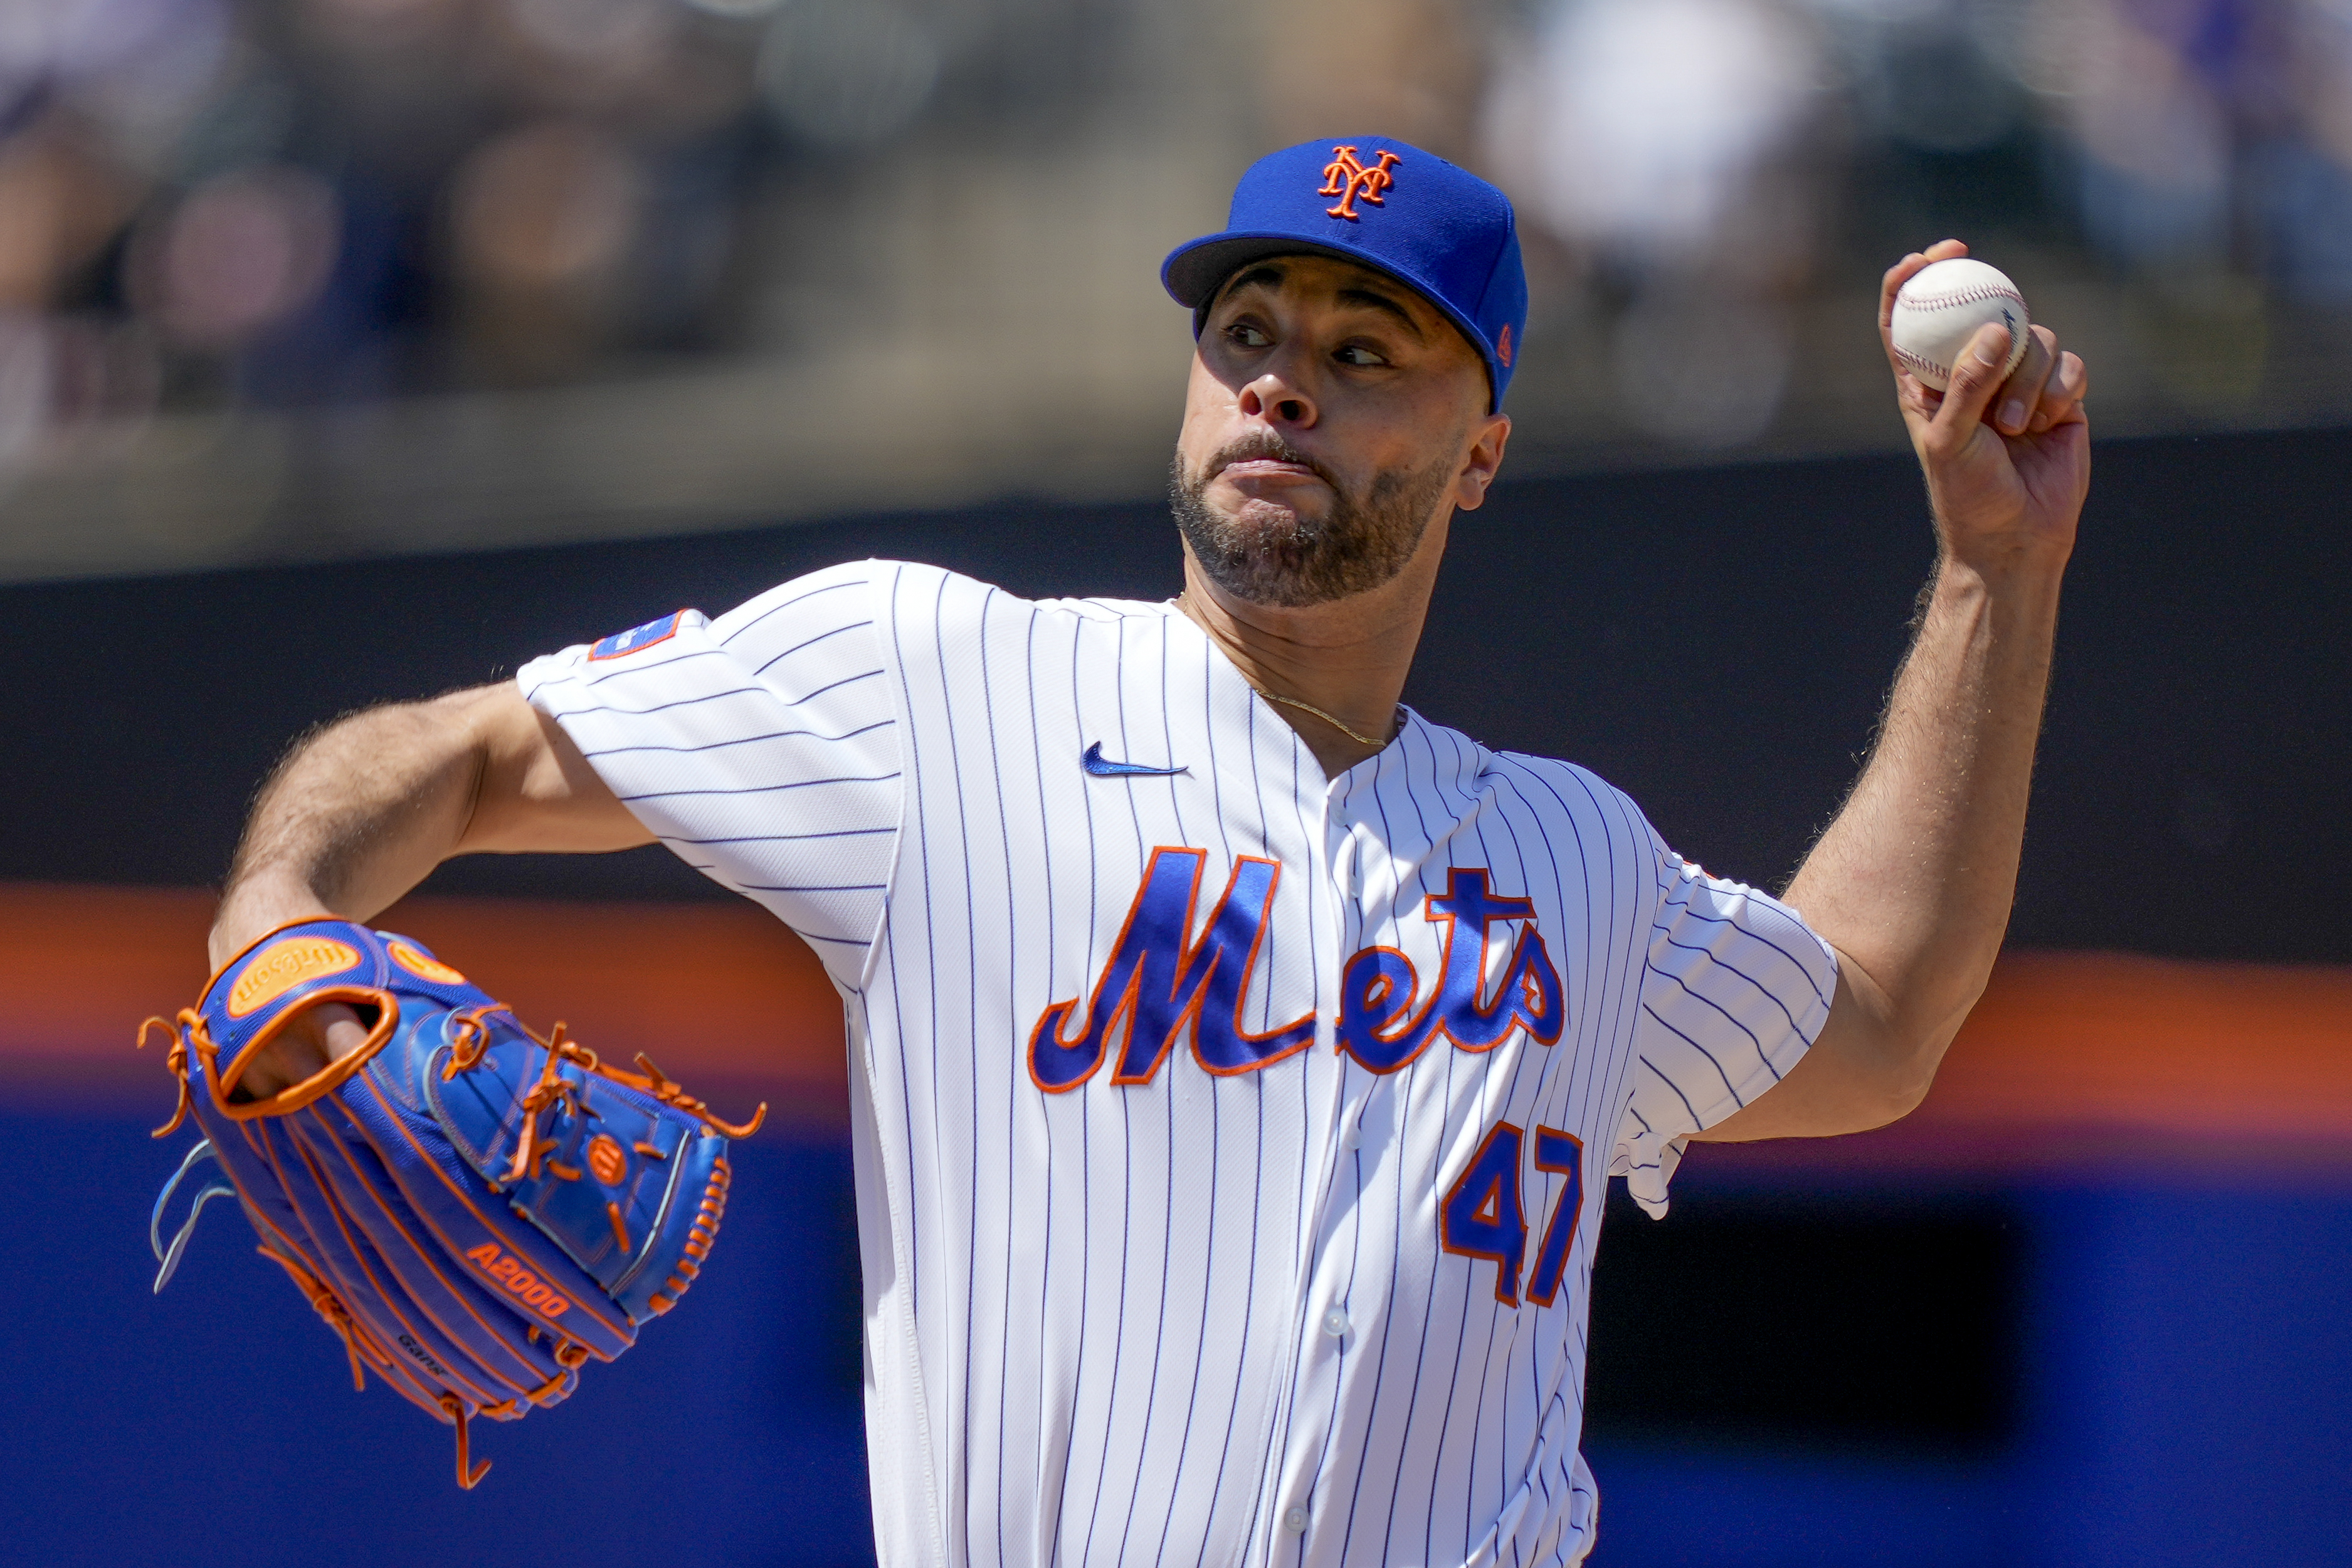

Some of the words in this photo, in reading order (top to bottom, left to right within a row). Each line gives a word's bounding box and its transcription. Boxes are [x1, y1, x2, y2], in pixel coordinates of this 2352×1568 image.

[237, 943, 349, 1002] Wilson
[1027, 845, 1564, 1094] Mets
[467, 1241, 570, 1318] A2000
[1440, 1120, 1584, 1308] 47
